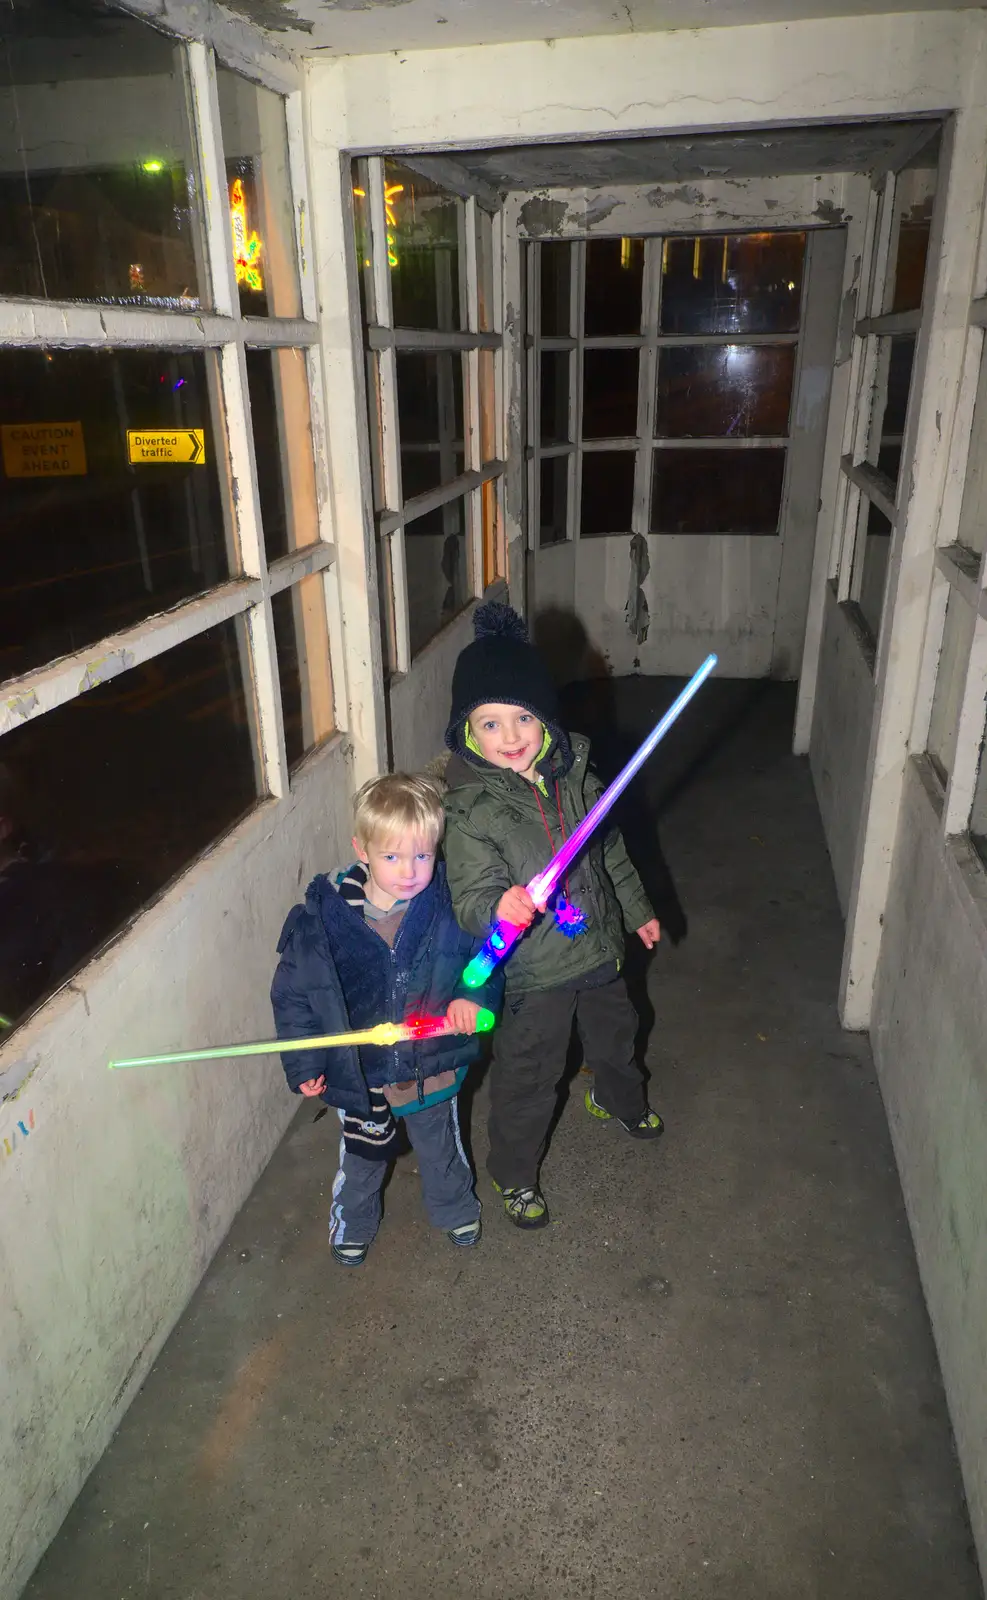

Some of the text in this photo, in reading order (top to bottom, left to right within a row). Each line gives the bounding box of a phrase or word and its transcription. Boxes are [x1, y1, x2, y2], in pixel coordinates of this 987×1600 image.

[10, 428, 74, 440] CAUTION
[135, 436, 177, 446] Diverted
[22, 444, 69, 456] EVENT
[141, 448, 173, 457] traffic
[22, 460, 70, 472] AHEAD
